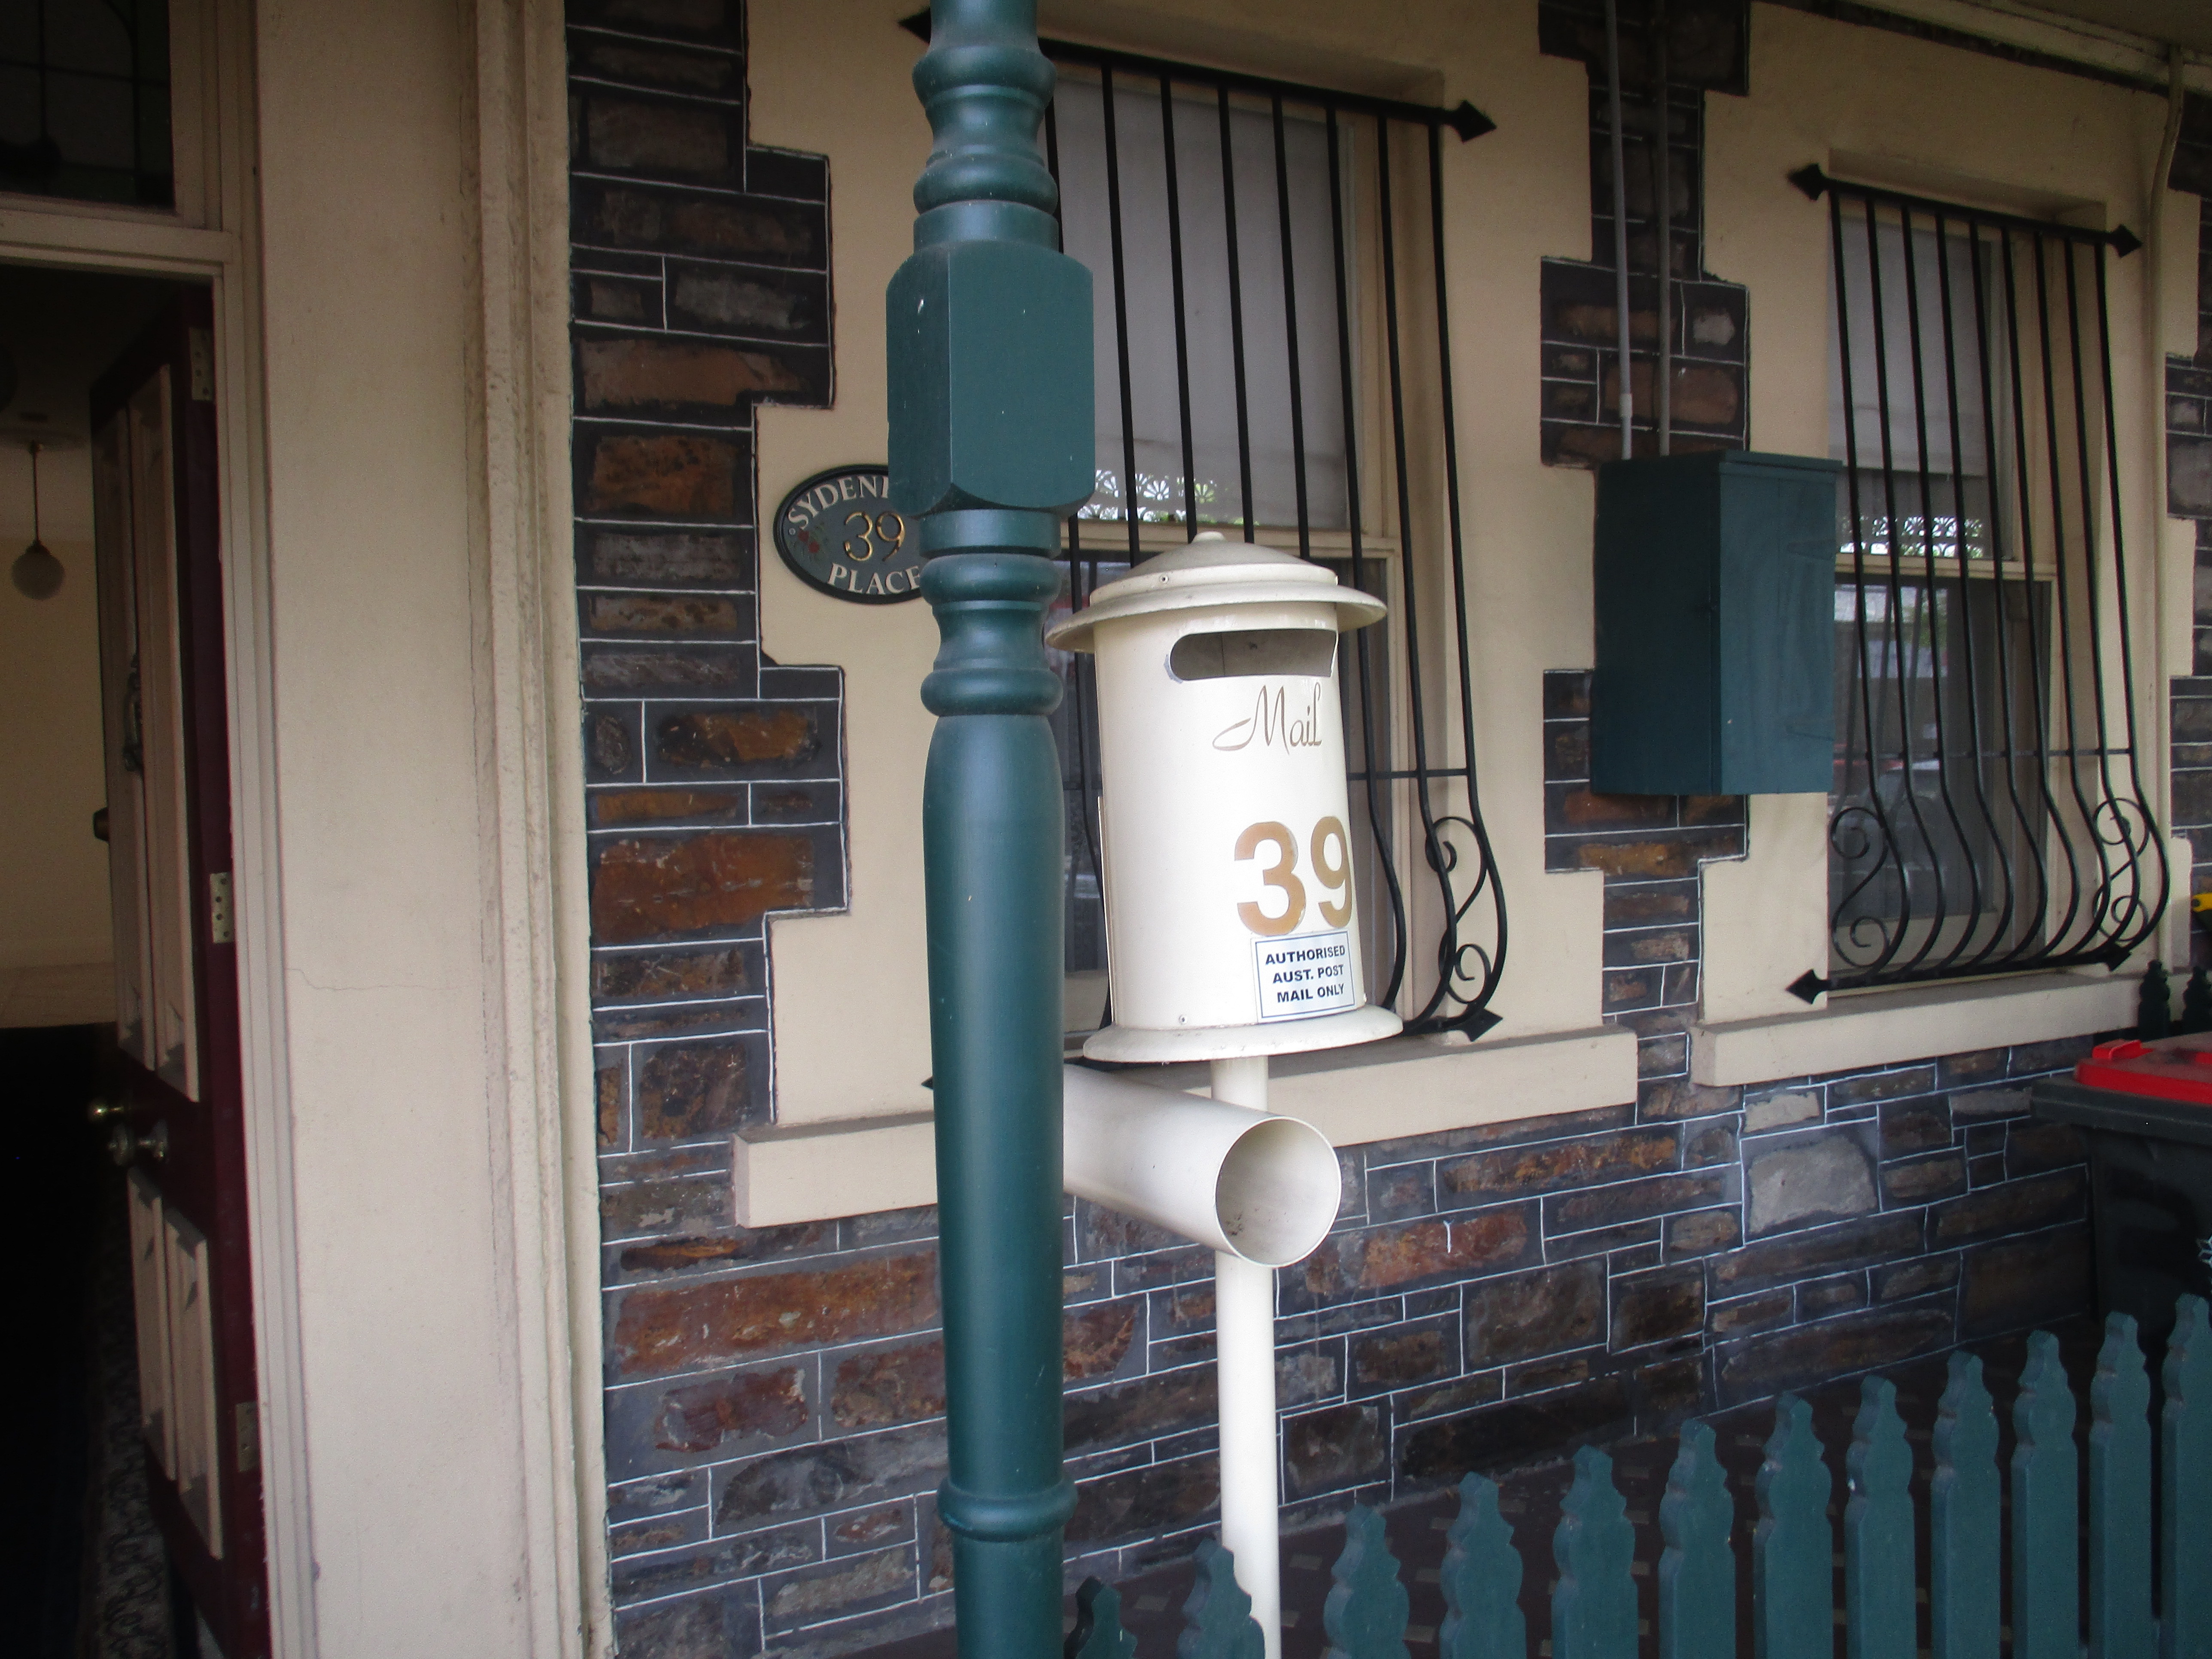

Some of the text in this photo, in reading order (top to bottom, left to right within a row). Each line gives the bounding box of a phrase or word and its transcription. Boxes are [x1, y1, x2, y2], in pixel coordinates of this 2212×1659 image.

[845, 511, 905, 562] 39
[827, 562, 920, 595] PLACE
[1212, 682, 1322, 755] Mail
[1234, 816, 1352, 936] 39
[1265, 945, 1345, 965] AUTHORISED
[1273, 964, 1344, 984] AUST. POST
[1277, 983, 1344, 1003] MAIL ONLY
